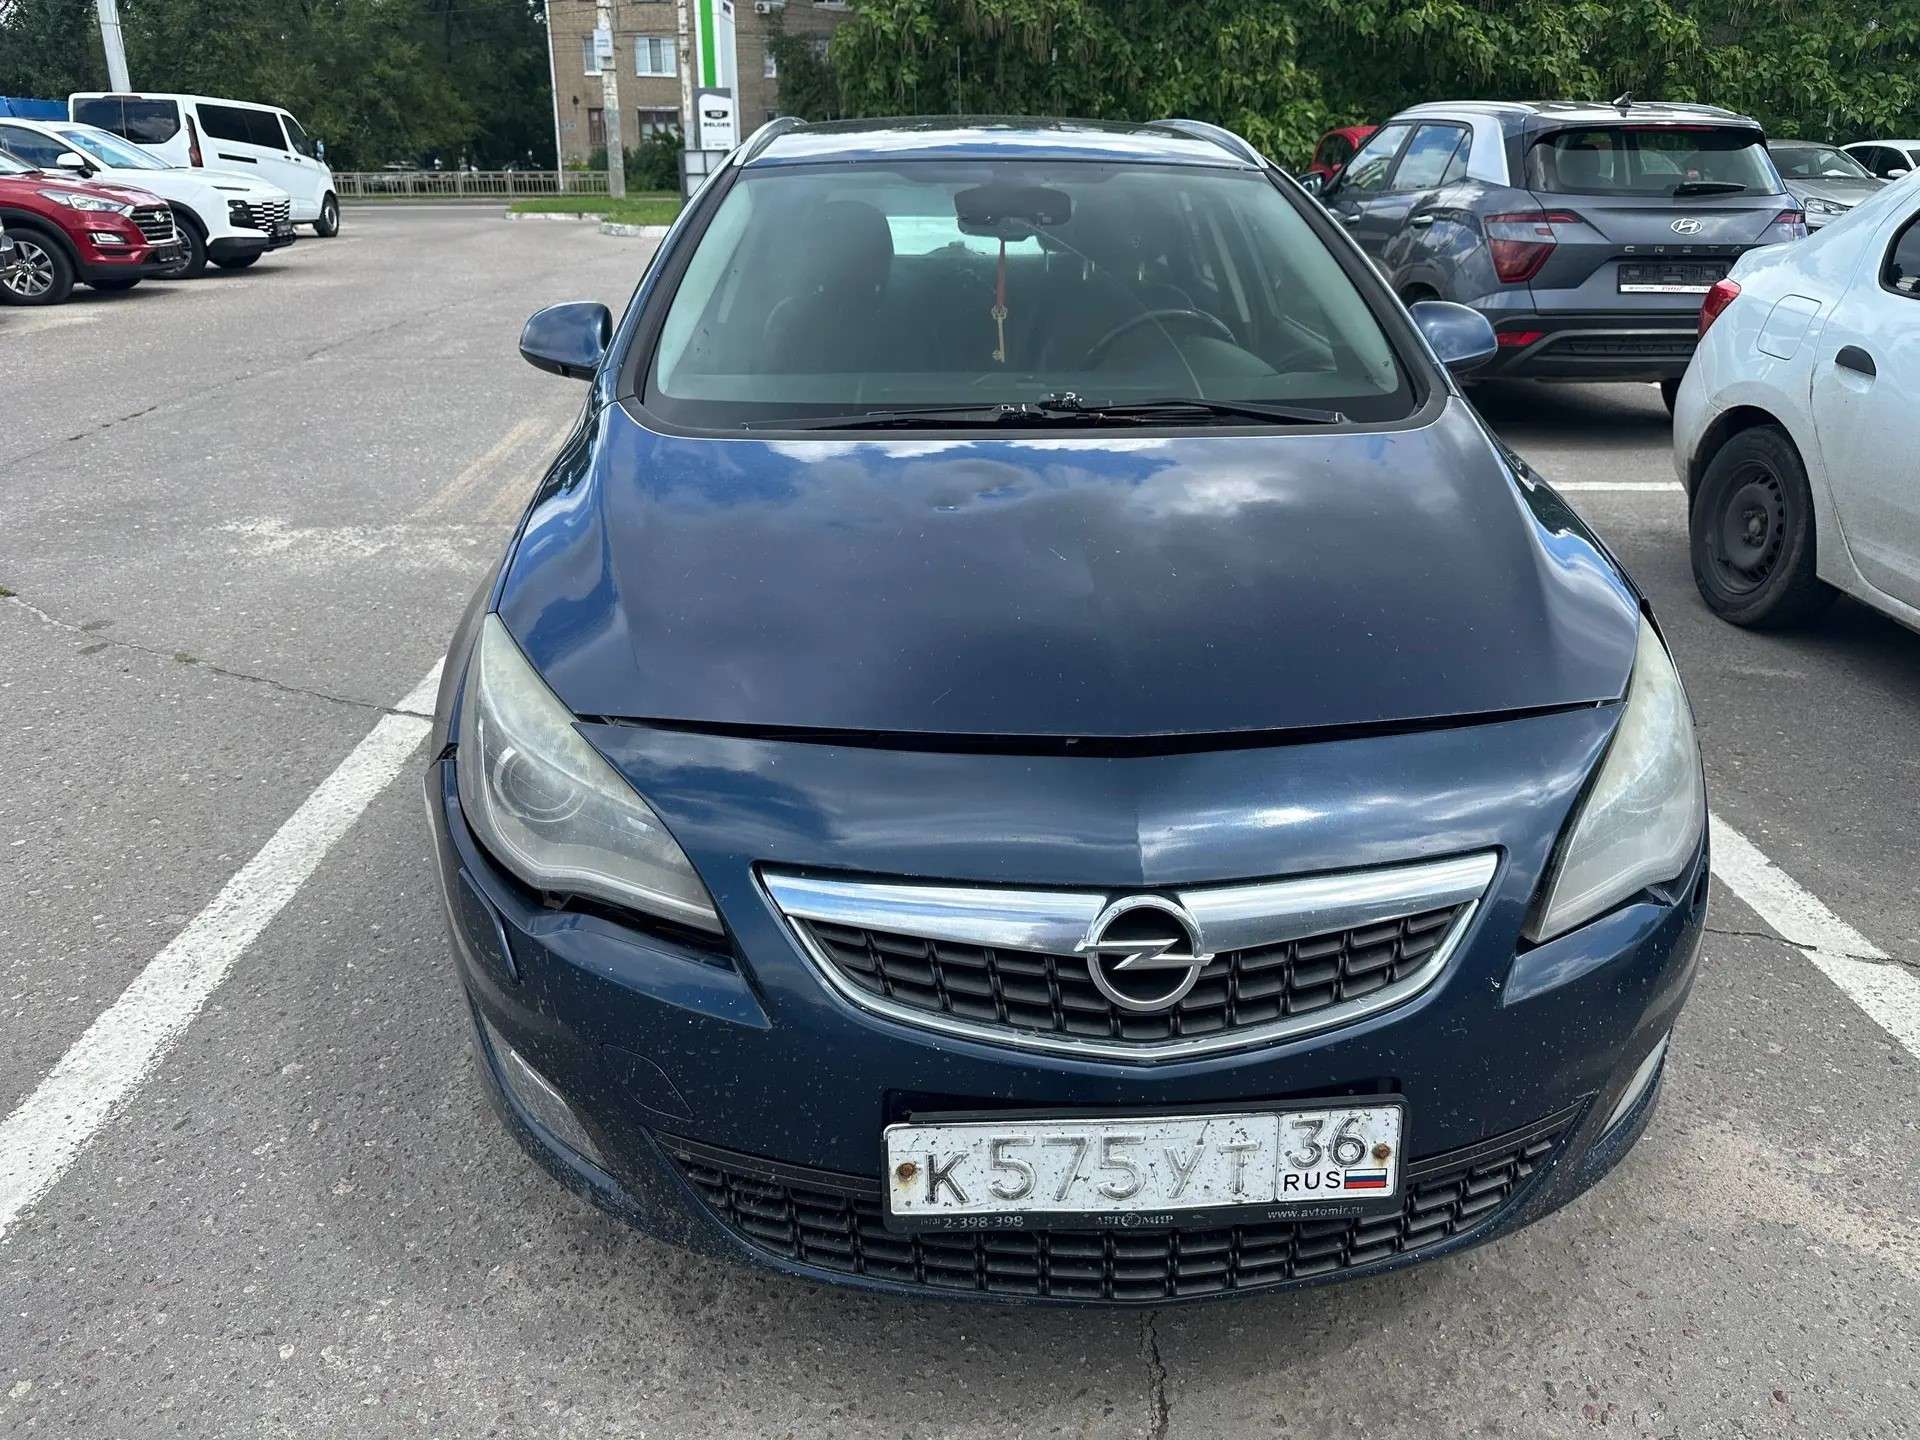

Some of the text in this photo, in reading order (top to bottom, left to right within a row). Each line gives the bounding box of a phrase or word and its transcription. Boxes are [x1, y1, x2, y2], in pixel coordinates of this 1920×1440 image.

[1624, 245, 1743, 254] CRETA
[1290, 1115, 1368, 1170] 36
[1283, 1171, 1341, 1192] RUS
[1267, 1205, 1364, 1219] www.avtomir.ru
[943, 1214, 1024, 1230] 2-398-398
